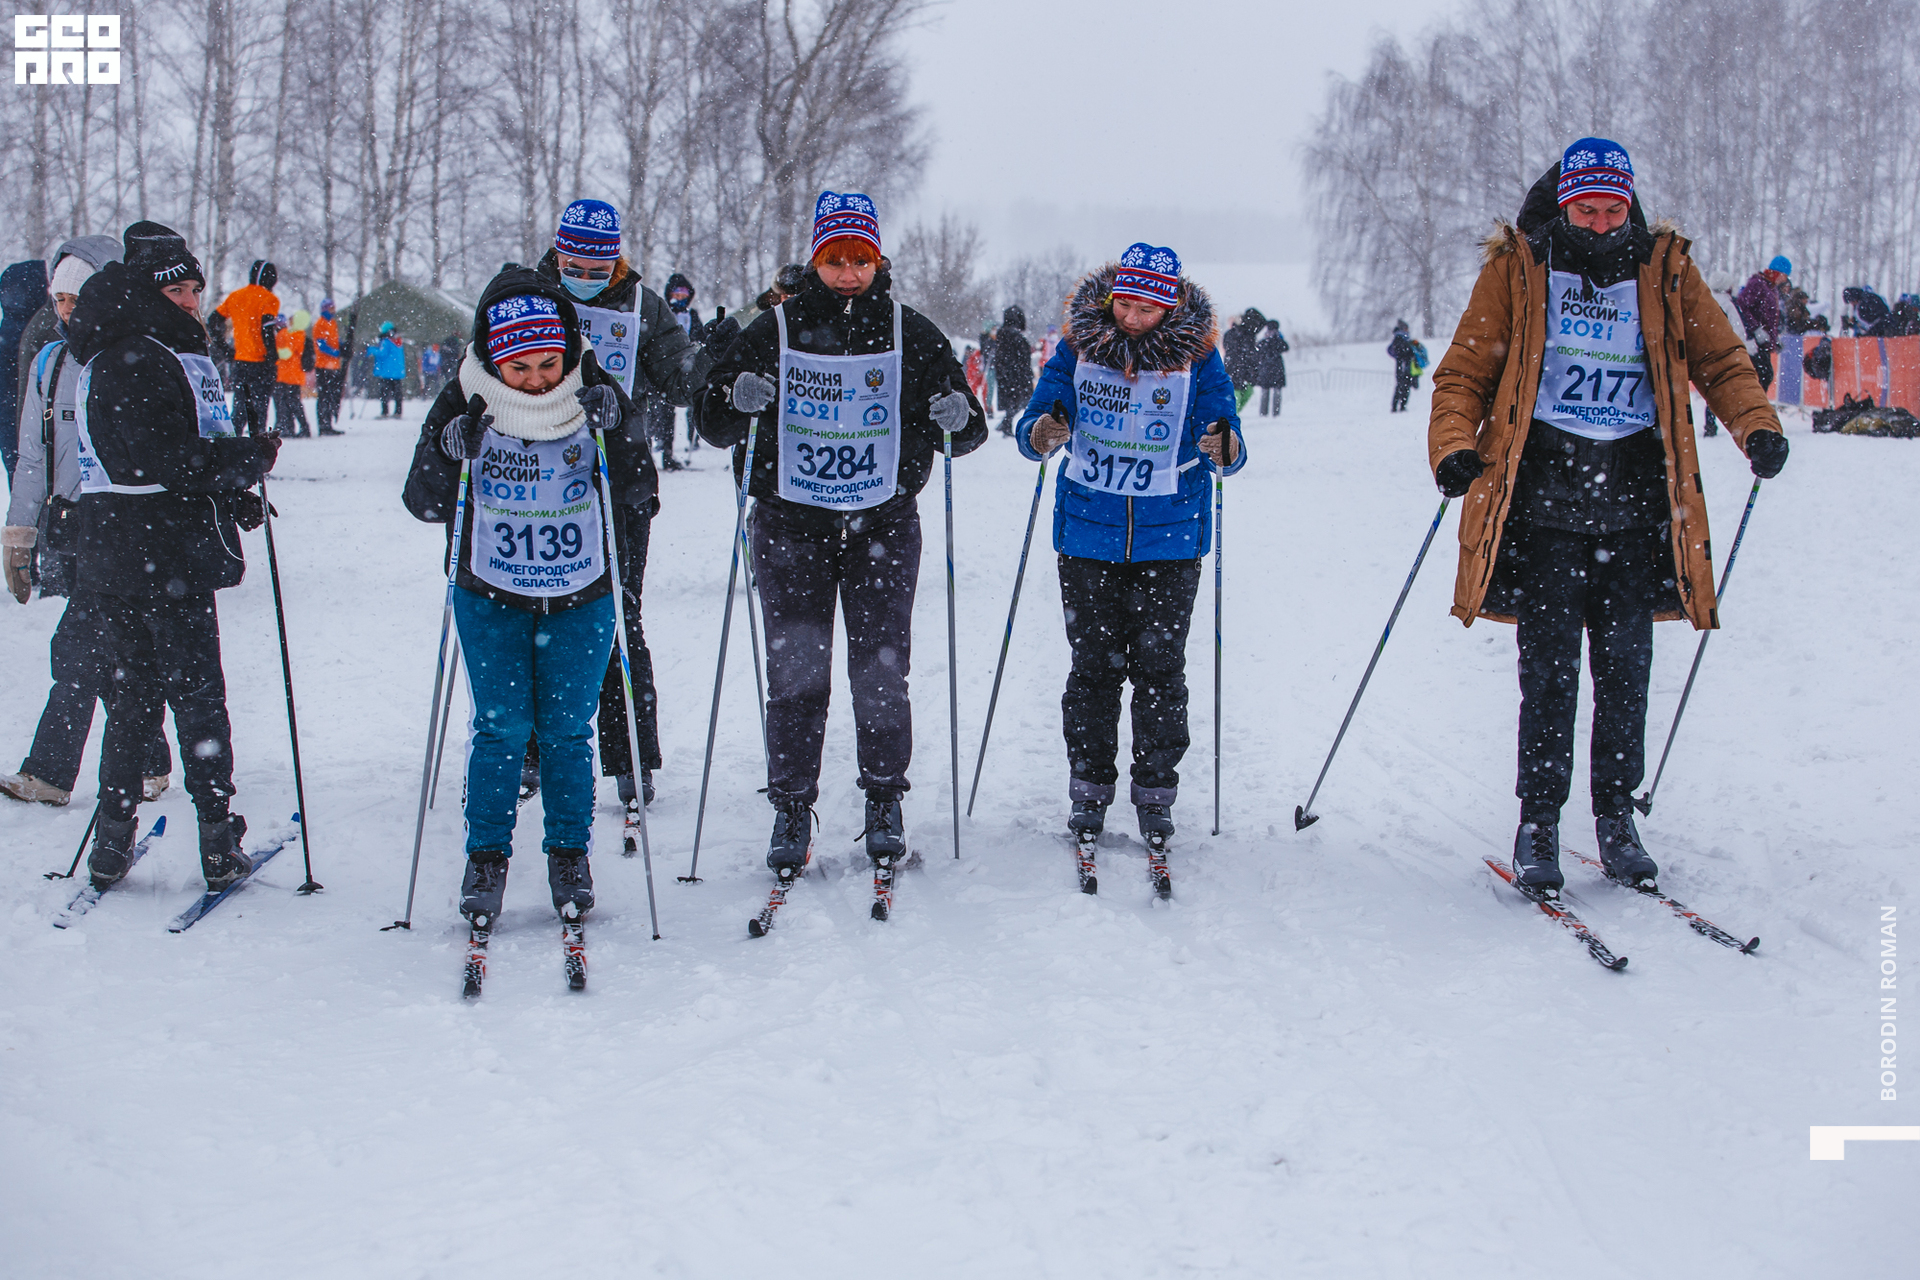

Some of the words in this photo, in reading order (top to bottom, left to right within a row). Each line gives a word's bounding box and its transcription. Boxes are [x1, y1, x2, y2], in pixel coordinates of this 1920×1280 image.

[1561, 301, 1618, 322] РОССИИ
[1559, 317, 1613, 341] 2021
[1557, 346, 1585, 357] СПОРТ
[1591, 350, 1626, 364] НОРМА
[786, 366, 842, 387] ЛЫЖНЯ
[1561, 364, 1645, 408] 2177
[787, 380, 843, 402] РОССИИ
[1079, 379, 1131, 400] ЛЫЖНЯ
[786, 397, 839, 421] 2021
[1079, 391, 1130, 414] РОССИИ
[1079, 407, 1124, 431] 2021
[786, 423, 814, 437] СПОРТ
[820, 430, 856, 440] НОРМА
[857, 427, 890, 439] ЖИЗНИ
[1104, 439, 1137, 450] НОРМА
[1138, 442, 1170, 453] ЖИЗНИ
[481, 461, 541, 482] РОССИИ
[796, 442, 878, 480] 3284
[1082, 448, 1154, 491] 3179
[481, 479, 537, 501] 2021
[790, 475, 884, 495] НИЖЕГОРОДСКАЯ
[518, 508, 557, 518] НОРМА
[558, 501, 592, 518] ЖИЗНИ
[494, 522, 583, 561] 3139
[489, 556, 592, 577] НИЖЕГОРОДСКАЯ
[512, 577, 570, 588] ОБЛАСТЬ
